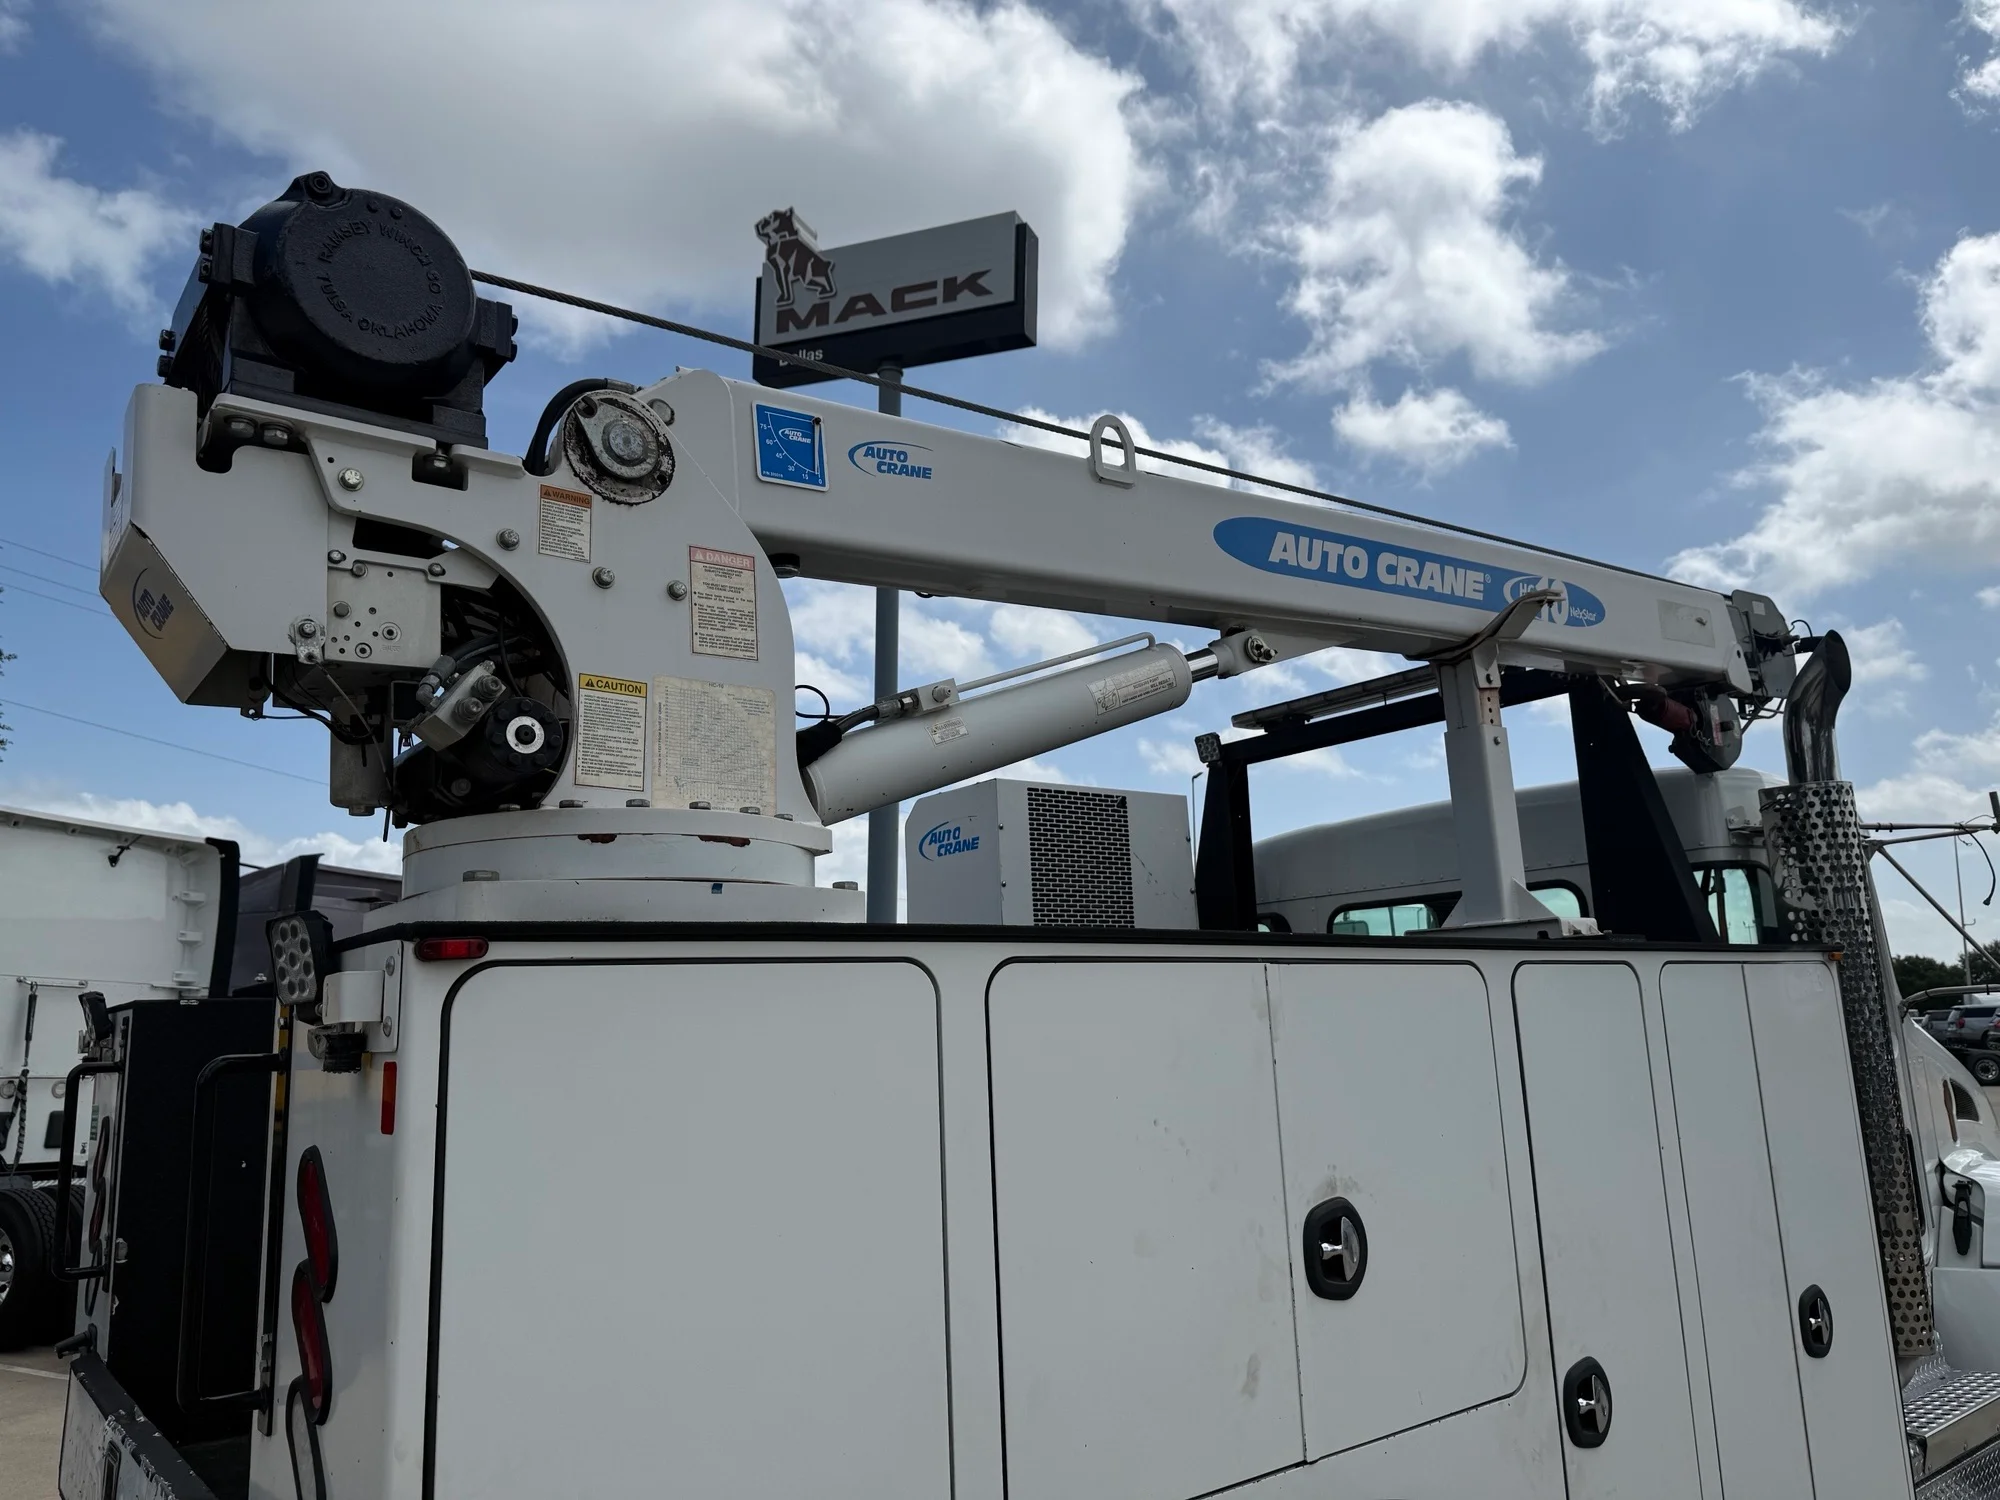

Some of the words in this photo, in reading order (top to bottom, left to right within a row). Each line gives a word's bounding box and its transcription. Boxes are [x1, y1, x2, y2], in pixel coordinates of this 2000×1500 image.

[318, 220, 370, 264] RAMSEY
[379, 222, 433, 267] WINCH
[317, 273, 353, 323] TULSA
[357, 303, 443, 340] OKLAHOMA
[776, 269, 993, 334] MACK
[779, 349, 824, 367] llas
[784, 429, 802, 437] AUTO
[789, 435, 812, 444] CRANE
[863, 446, 908, 463] AUTO
[876, 461, 933, 480] CRANE
[552, 490, 590, 505] WARNING
[706, 552, 750, 567] DANGER
[1268, 531, 1369, 580] AUTO
[136, 588, 155, 621] AUTO
[150, 593, 175, 632] CRANE
[596, 679, 642, 694] CAUTION
[928, 826, 960, 846] AUTO
[937, 836, 979, 857] CRANE
